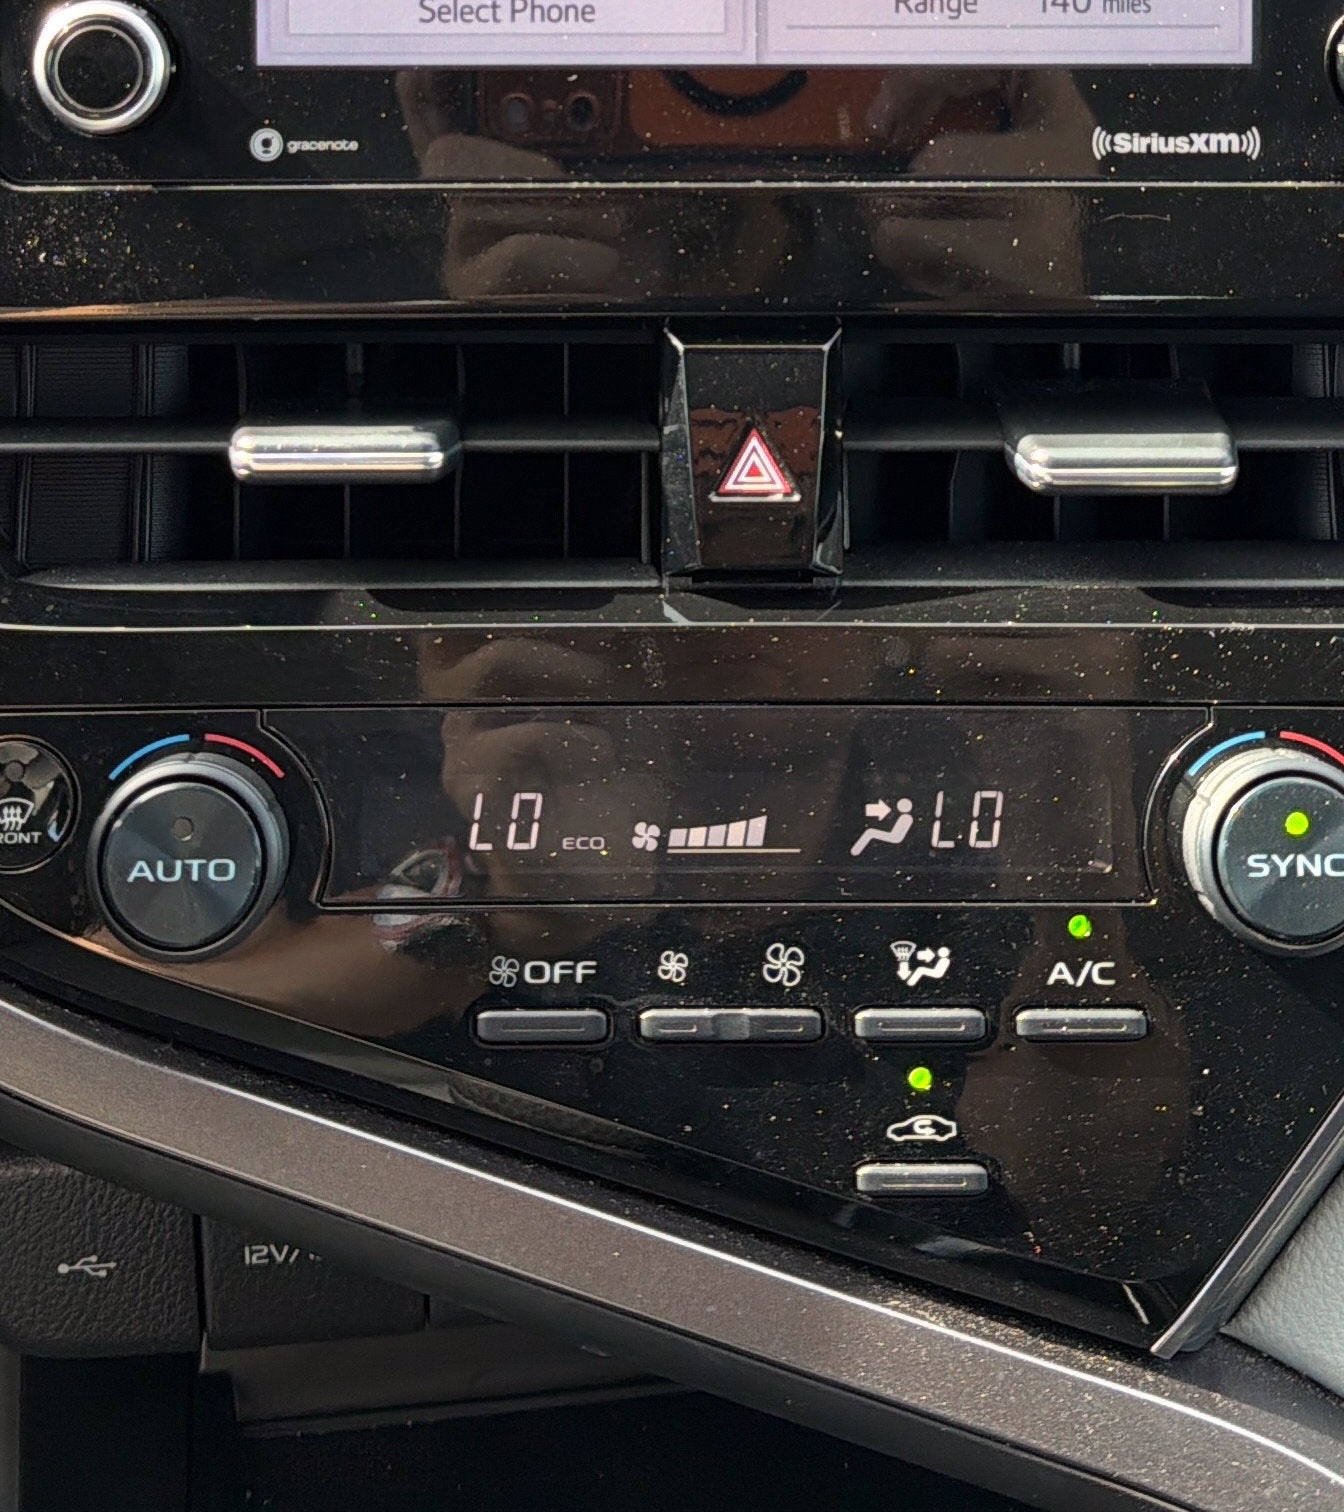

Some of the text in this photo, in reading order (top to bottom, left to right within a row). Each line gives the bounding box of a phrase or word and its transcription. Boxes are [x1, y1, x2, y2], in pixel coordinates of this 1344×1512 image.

[287, 139, 359, 154] gracenote
[468, 792, 544, 852] LO
[931, 790, 1005, 849] LO
[562, 835, 606, 851] ECO
[126, 858, 236, 883] AUTO
[523, 960, 598, 984] OFF
[1047, 960, 1117, 987] A/C
